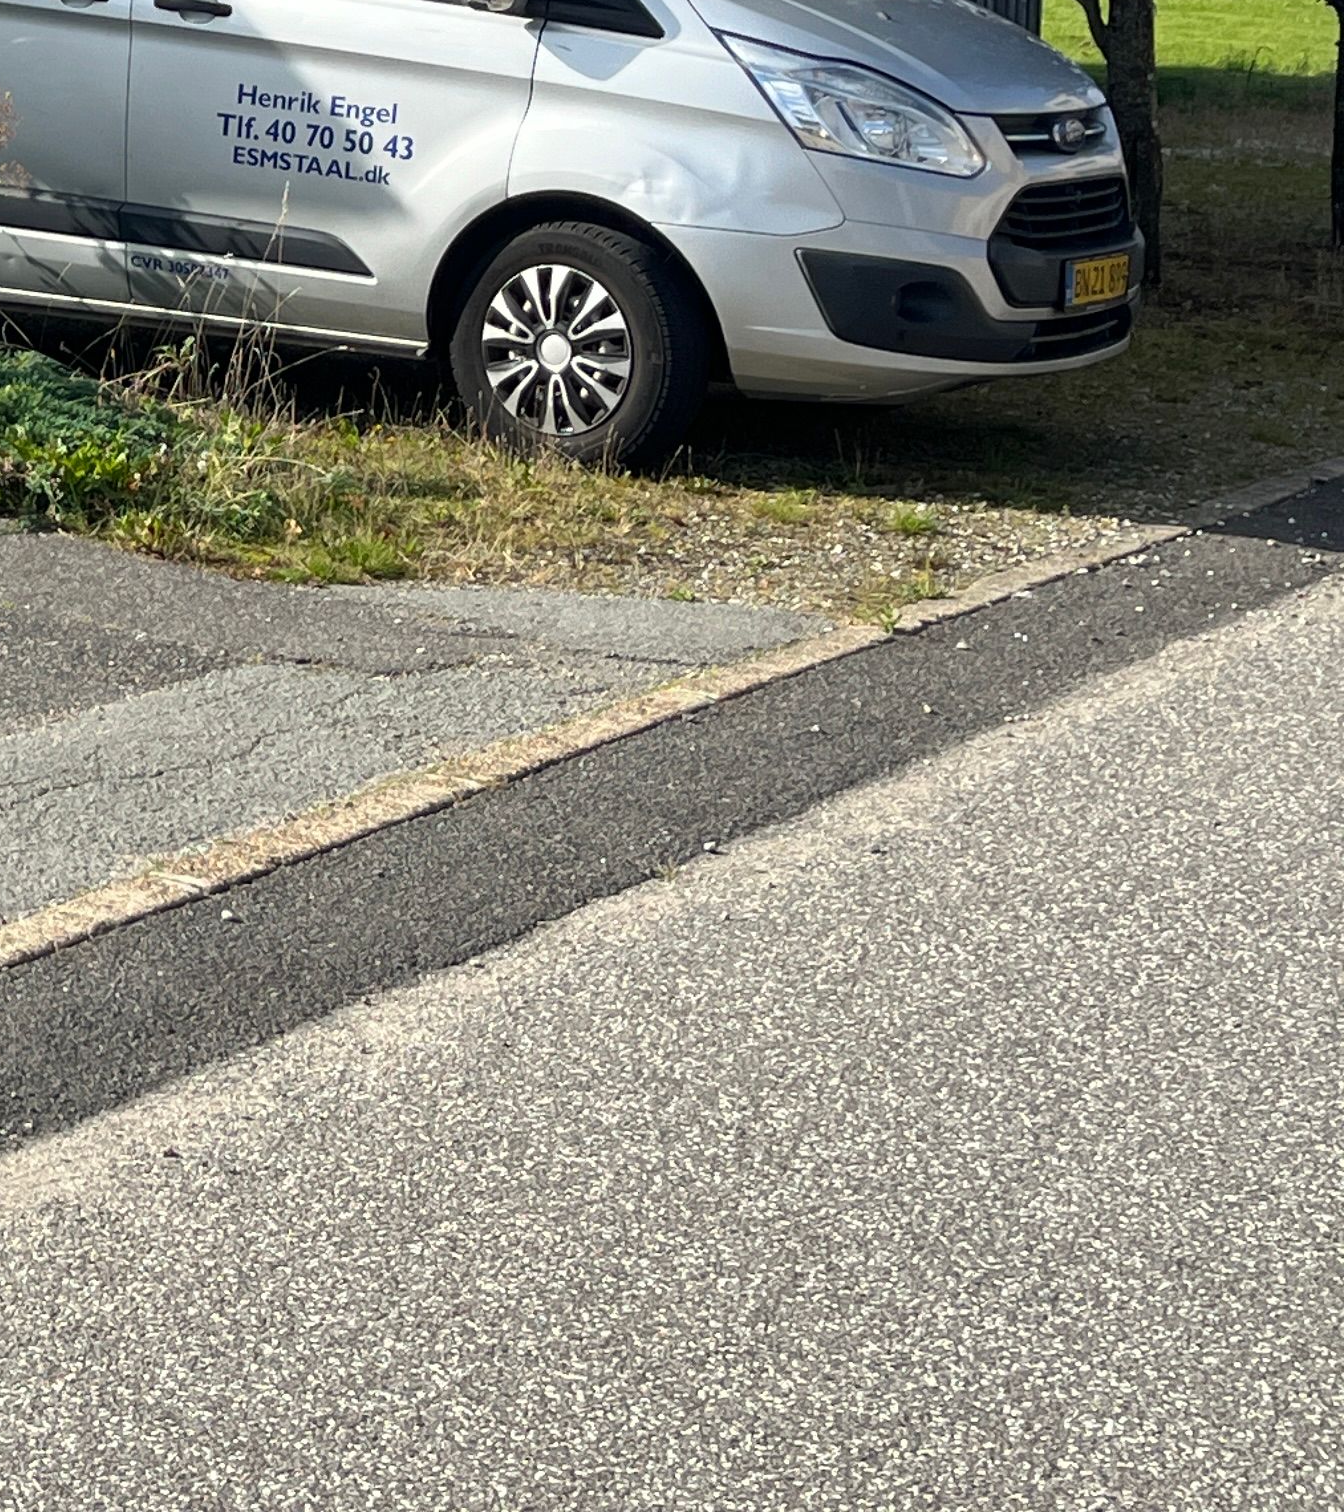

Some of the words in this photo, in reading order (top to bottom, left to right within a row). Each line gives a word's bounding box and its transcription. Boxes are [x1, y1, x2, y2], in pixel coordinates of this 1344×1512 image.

[237, 83, 321, 115] Henrik
[330, 96, 398, 128] Engel
[217, 112, 260, 141] Tlf.
[265, 119, 297, 144] 40
[306, 124, 335, 149] 70
[342, 129, 374, 155] 50
[383, 134, 415, 160] 43
[232, 145, 391, 186] ESMSTAAL.dk
[130, 255, 164, 271] CVR
